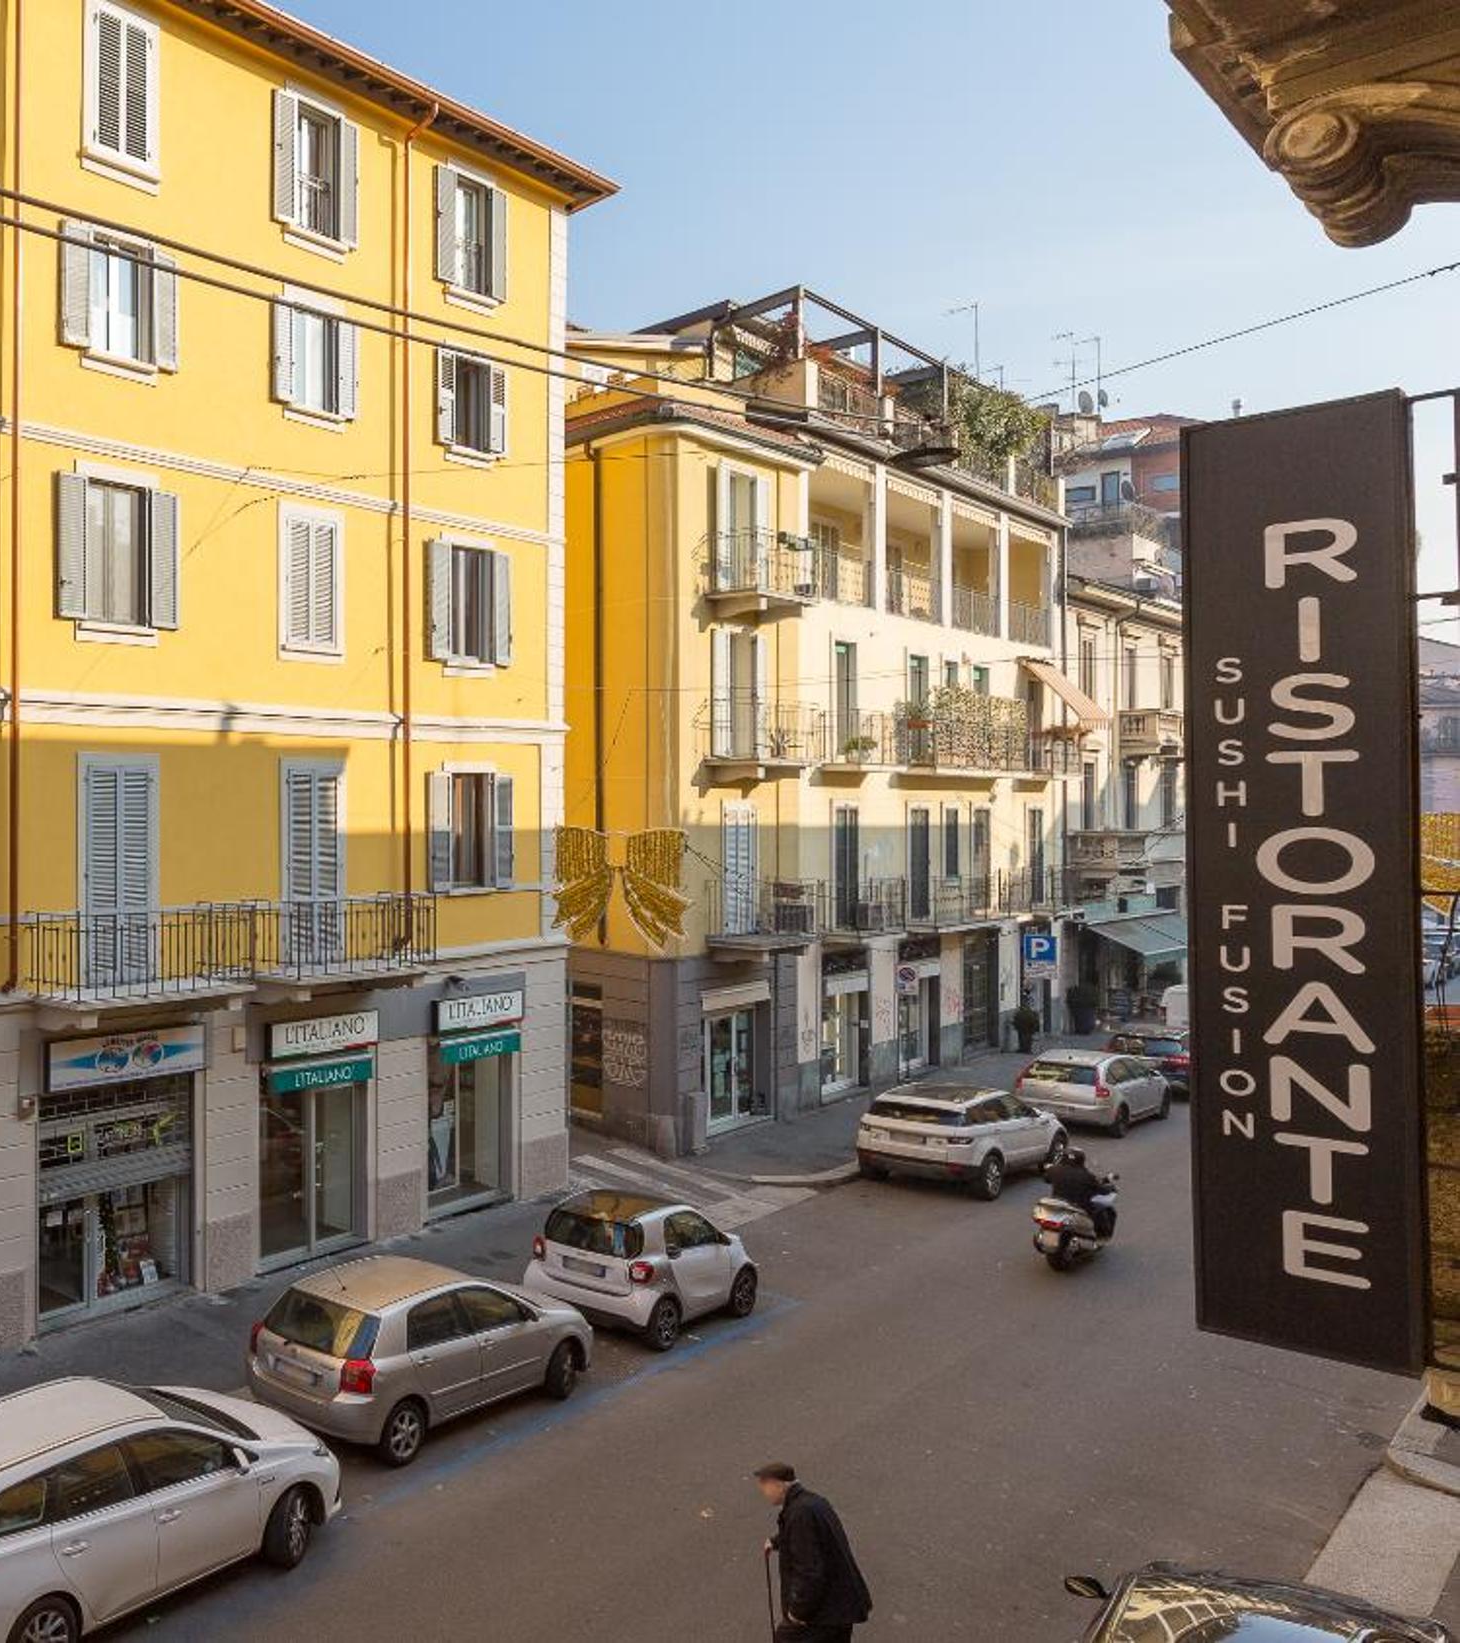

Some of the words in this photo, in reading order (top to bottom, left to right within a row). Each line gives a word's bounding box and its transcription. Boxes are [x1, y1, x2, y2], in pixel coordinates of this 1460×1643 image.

[1215, 657, 1247, 848] SUSHI
[1030, 937, 1051, 959] P
[1255, 517, 1376, 1289] RISTORANTE
[1220, 904, 1256, 1139] FUSION
